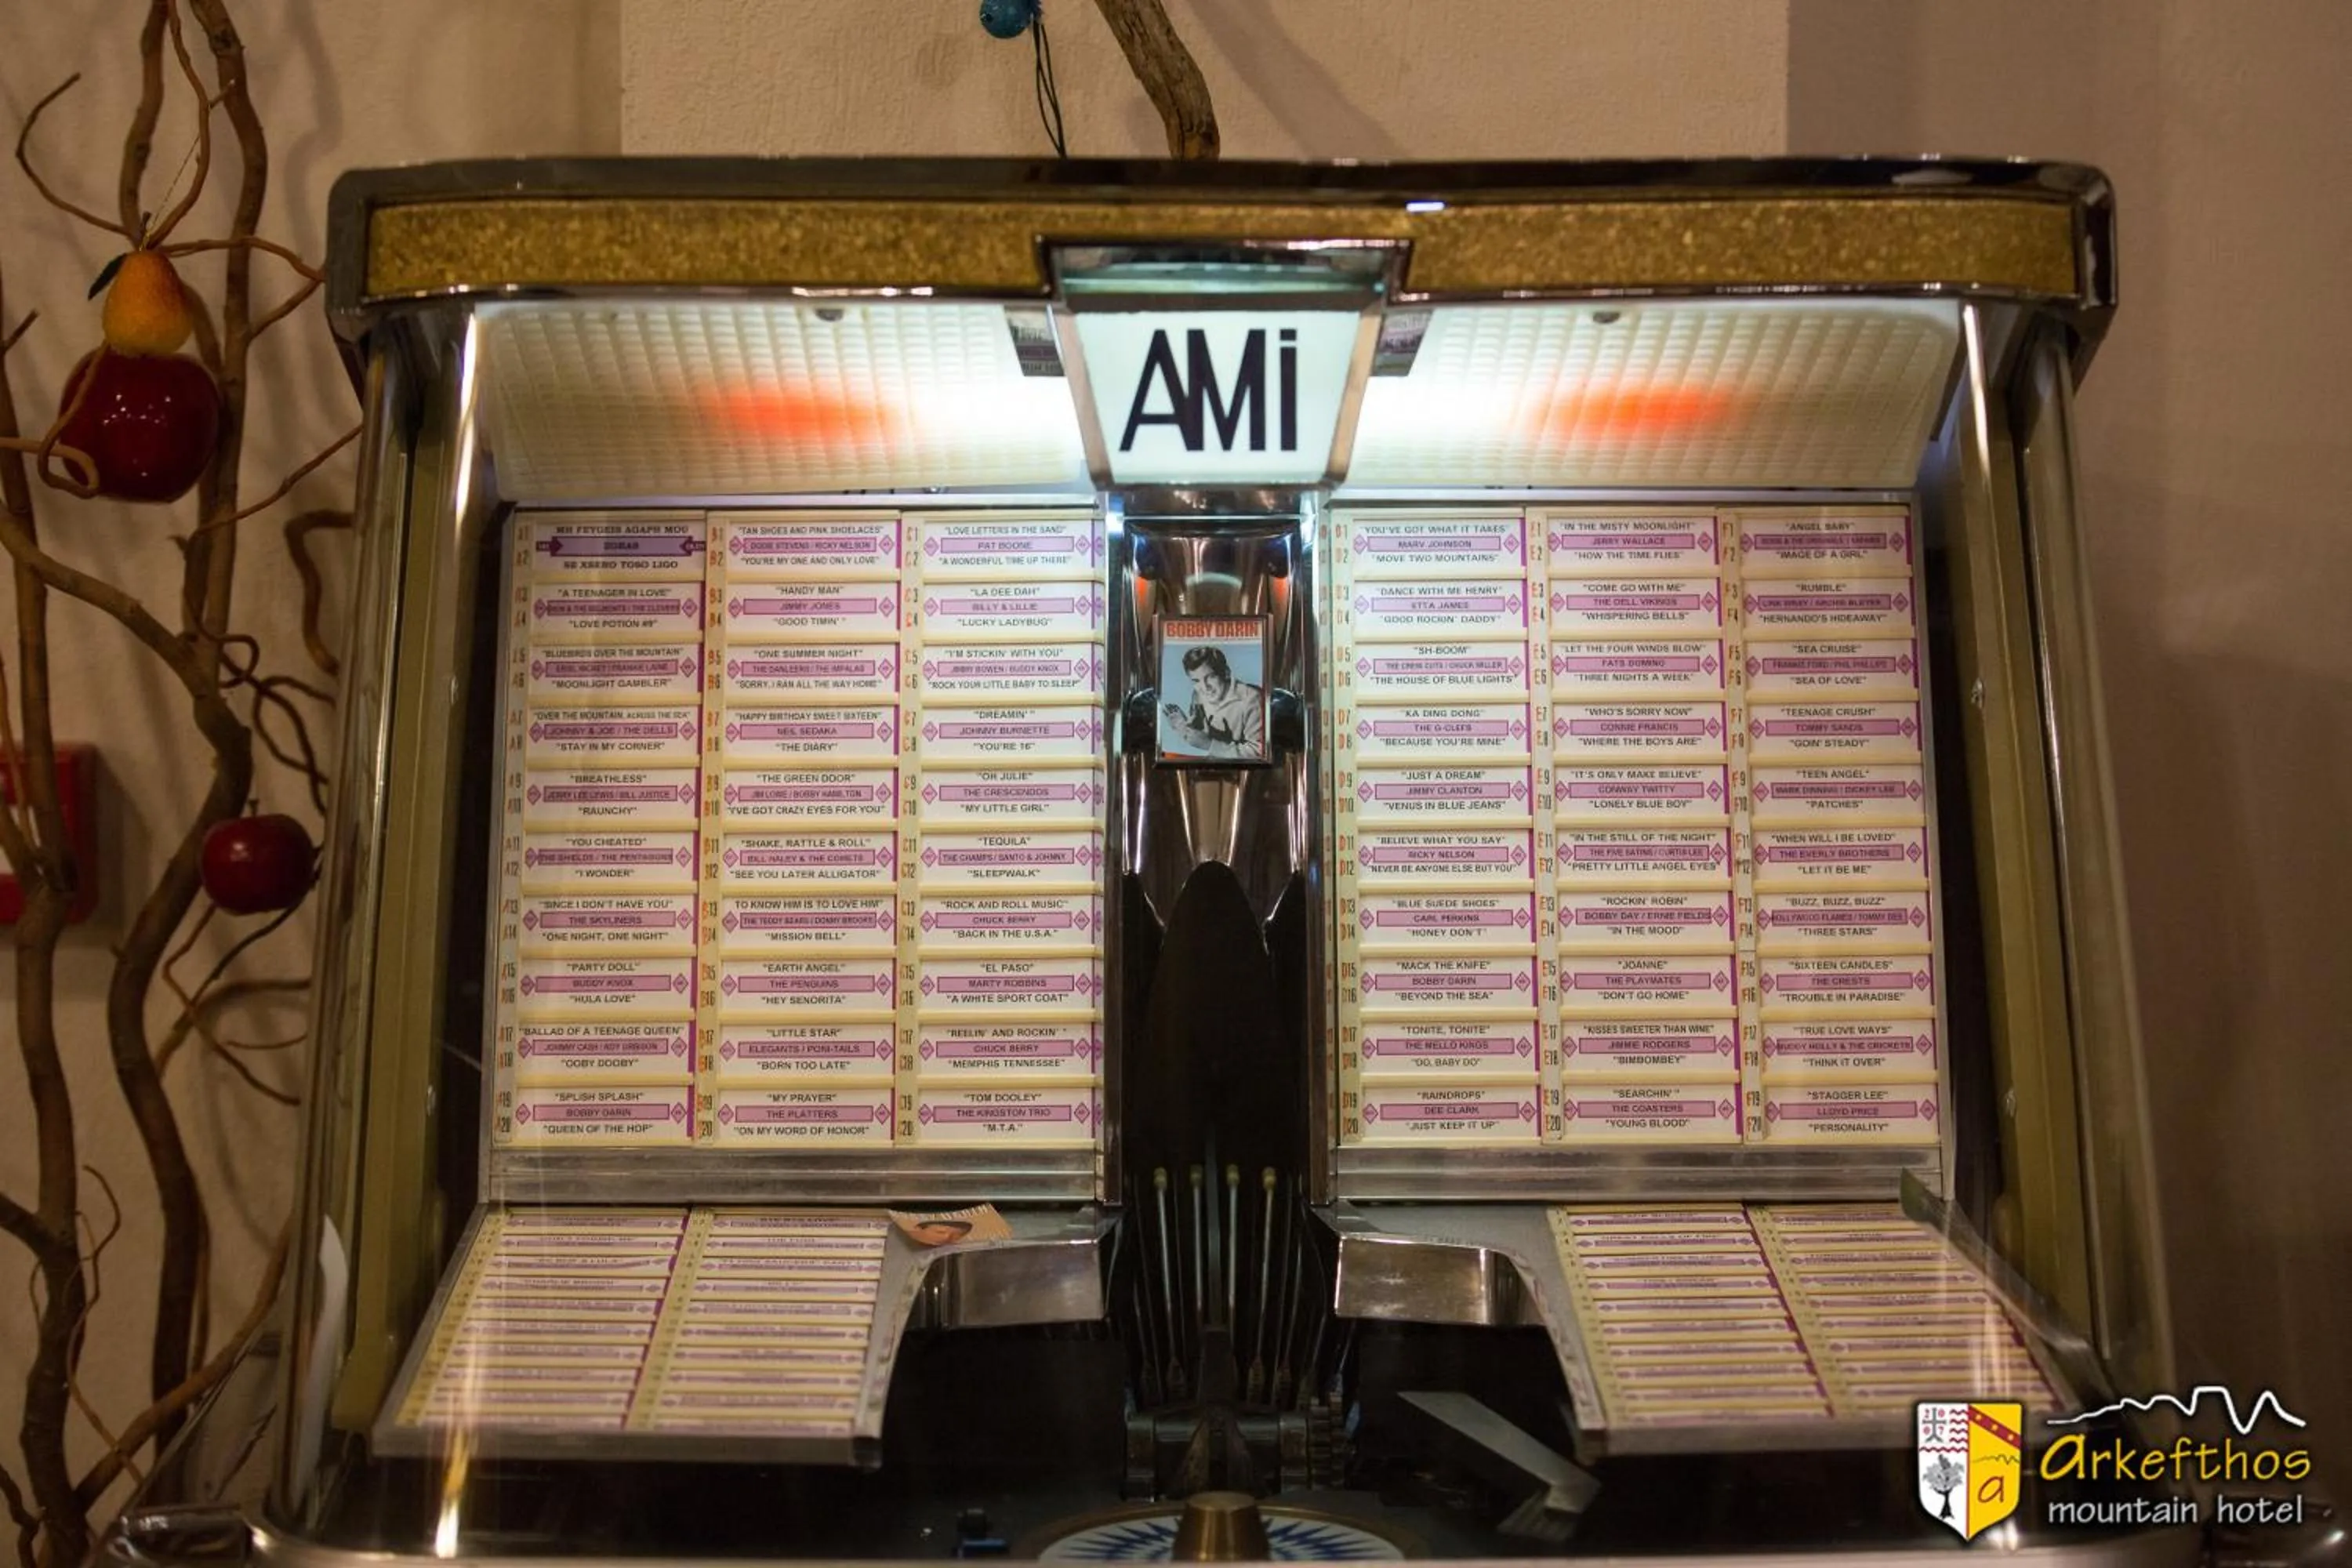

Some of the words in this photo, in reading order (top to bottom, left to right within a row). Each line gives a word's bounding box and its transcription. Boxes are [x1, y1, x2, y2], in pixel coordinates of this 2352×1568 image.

[1120, 328, 1298, 451] AMi
[1621, 584, 1635, 593] GO
[1639, 584, 1664, 593] WITH
[782, 649, 825, 658] SUMMER
[1818, 676, 1831, 684] OF
[589, 742, 598, 751] IN
[601, 742, 615, 751] MY
[1436, 738, 1474, 746] YOU'RE
[784, 774, 818, 782] GREEN
[1435, 771, 1442, 780] A
[983, 804, 1018, 813] LITTLE
[1425, 801, 1435, 811] IN
[1438, 801, 1465, 811] BLUE
[1636, 800, 1663, 808] BLUE
[757, 869, 779, 878] YOU
[782, 869, 815, 878] LATER
[1433, 961, 1454, 970] THE
[1412, 977, 1445, 985] BOBBY
[1447, 977, 1476, 985] DARIN
[961, 994, 994, 1004] WHITE
[997, 994, 1032, 1004] SPORT
[1446, 992, 1465, 1001] THE
[795, 1062, 817, 1070] TOO
[1841, 1058, 1849, 1066] IT
[766, 1110, 785, 1119] THE
[787, 1110, 838, 1119] PLATTERS
[586, 1124, 601, 1134] OF
[604, 1124, 624, 1134] THE
